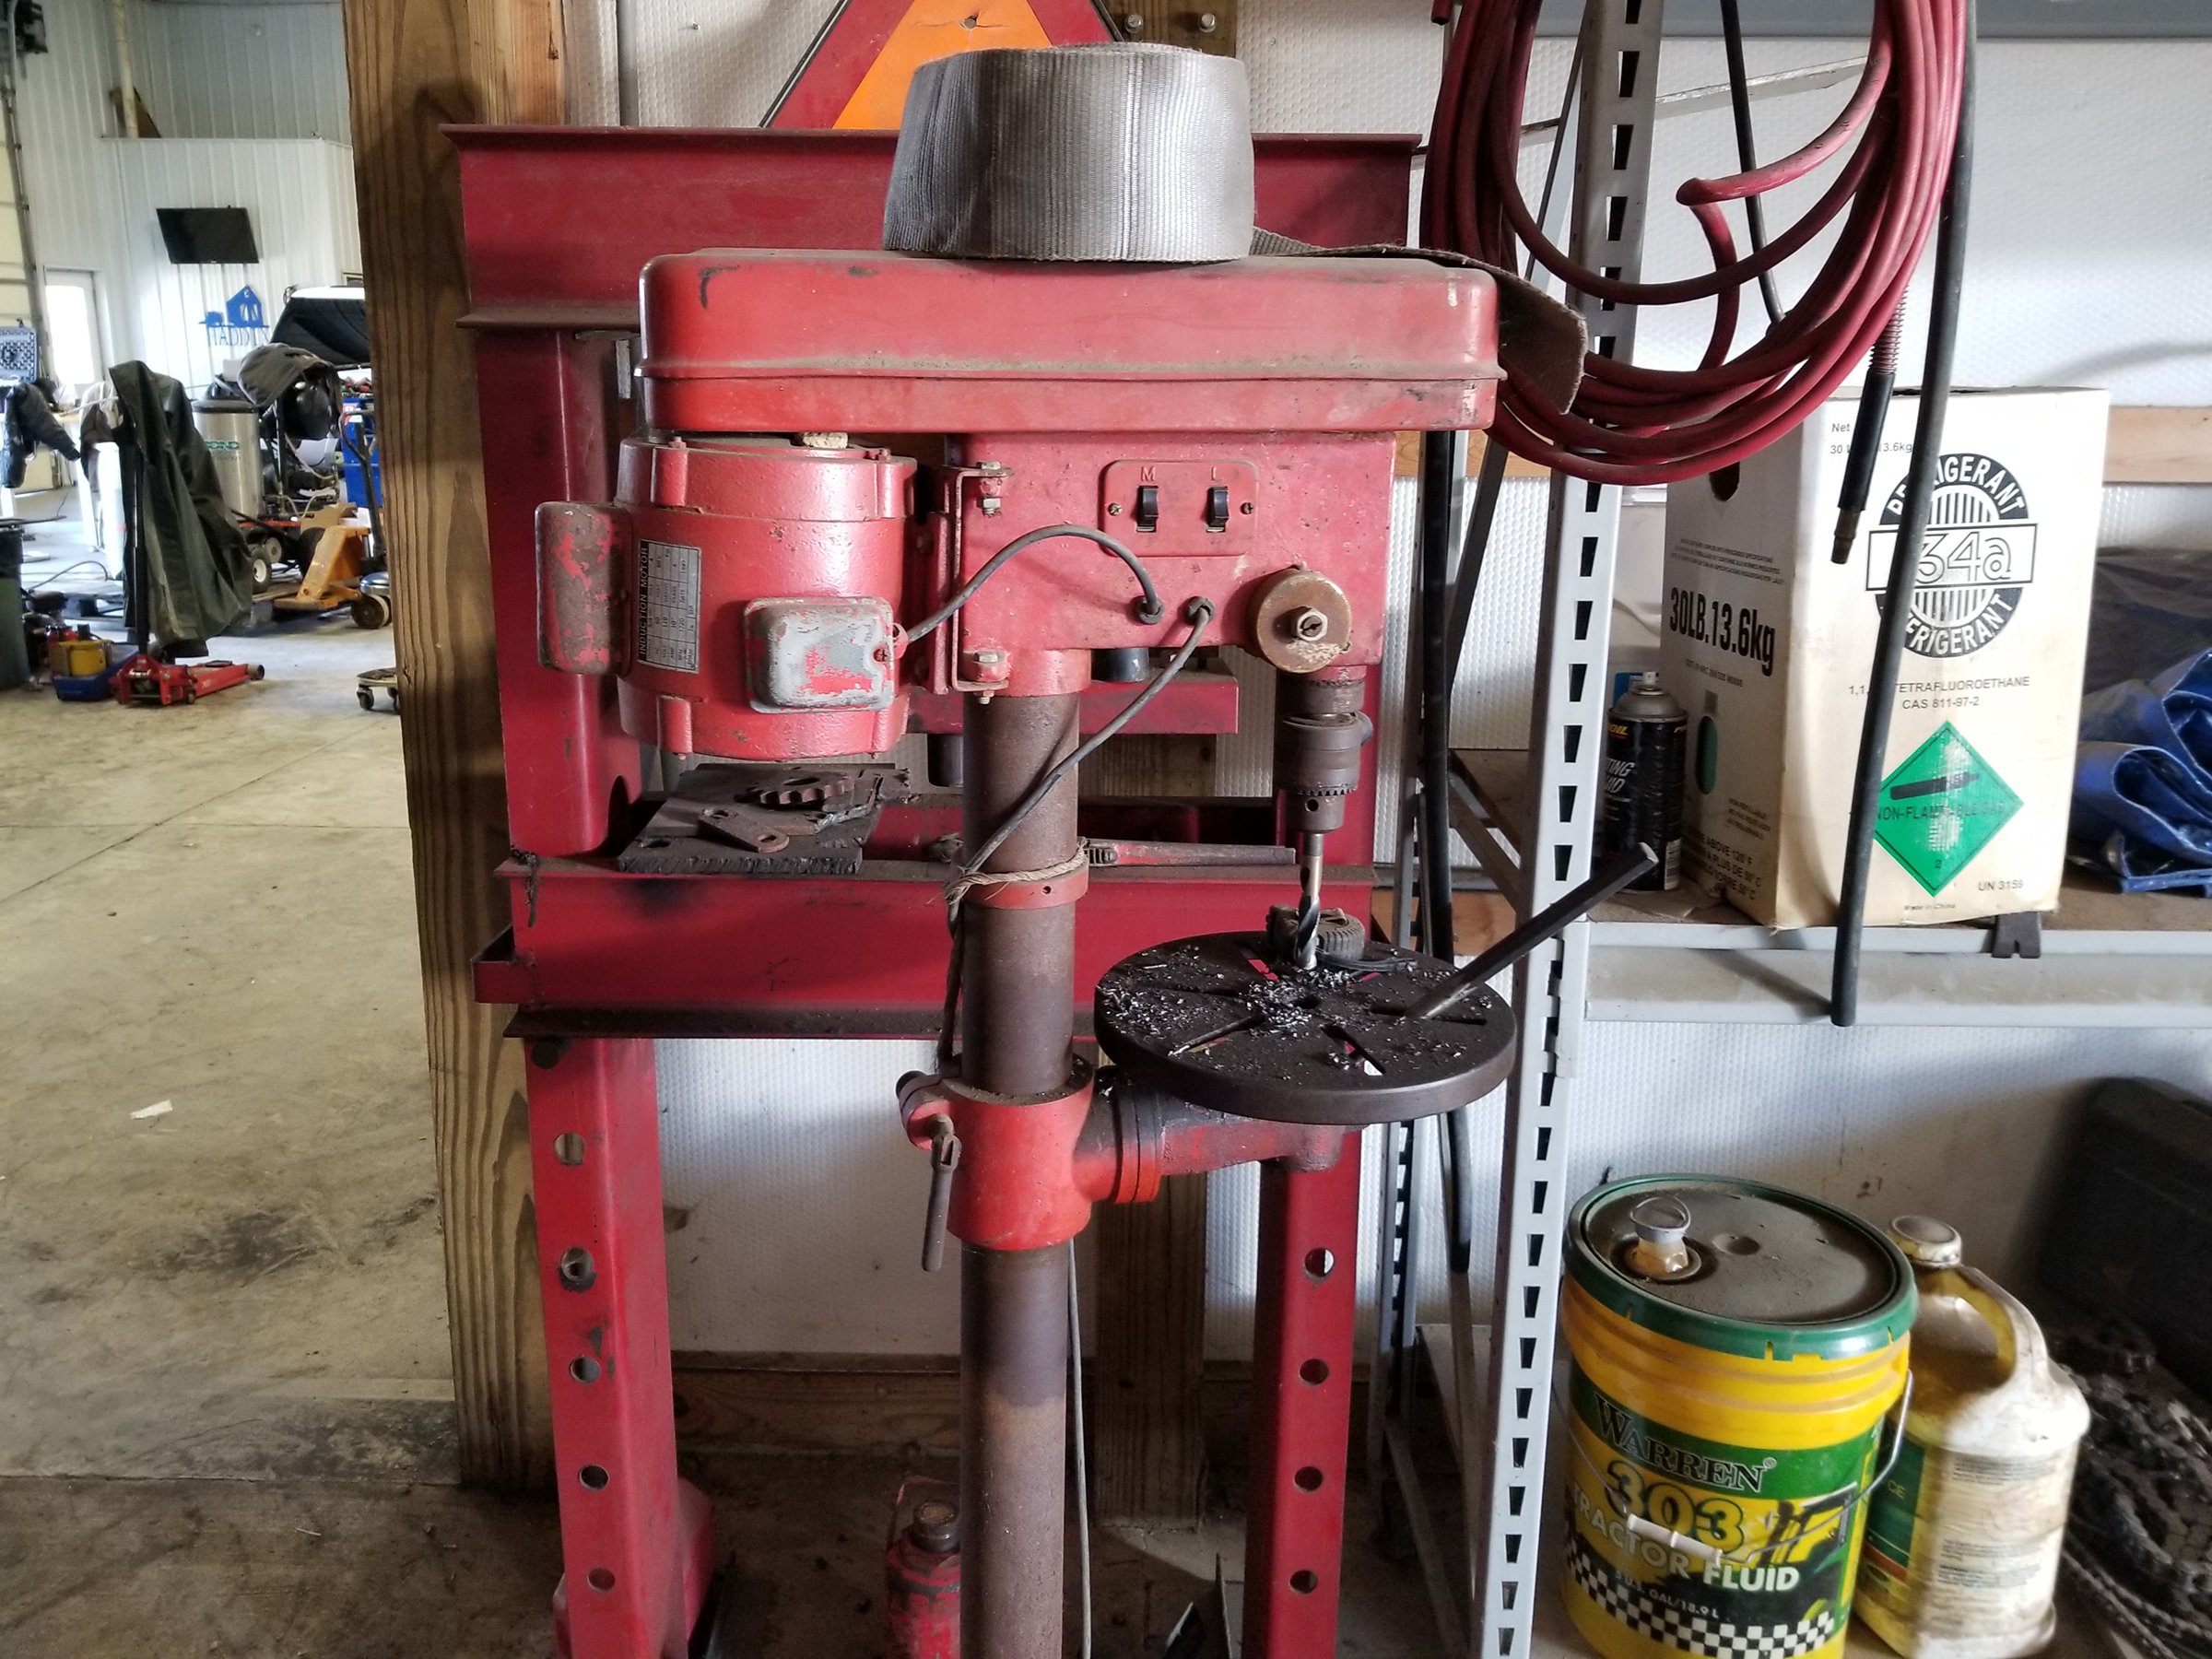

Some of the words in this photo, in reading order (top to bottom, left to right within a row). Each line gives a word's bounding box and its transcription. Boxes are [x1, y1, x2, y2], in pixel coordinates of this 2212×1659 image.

[1831, 423, 1851, 432] Net
[1830, 444, 1843, 454] 30
[1140, 466, 1157, 482] M
[1210, 466, 1223, 482] L
[640, 594, 648, 655] INDUCTION
[1902, 699, 1928, 709] CAS
[1932, 696, 1981, 708] 811-97-2
[1935, 859, 1943, 869] 2
[1978, 881, 1994, 891] UN
[1594, 1393, 1765, 1493] WARREN
[1605, 1459, 1745, 1556] 303
[1703, 1563, 1801, 1592] FLUID
